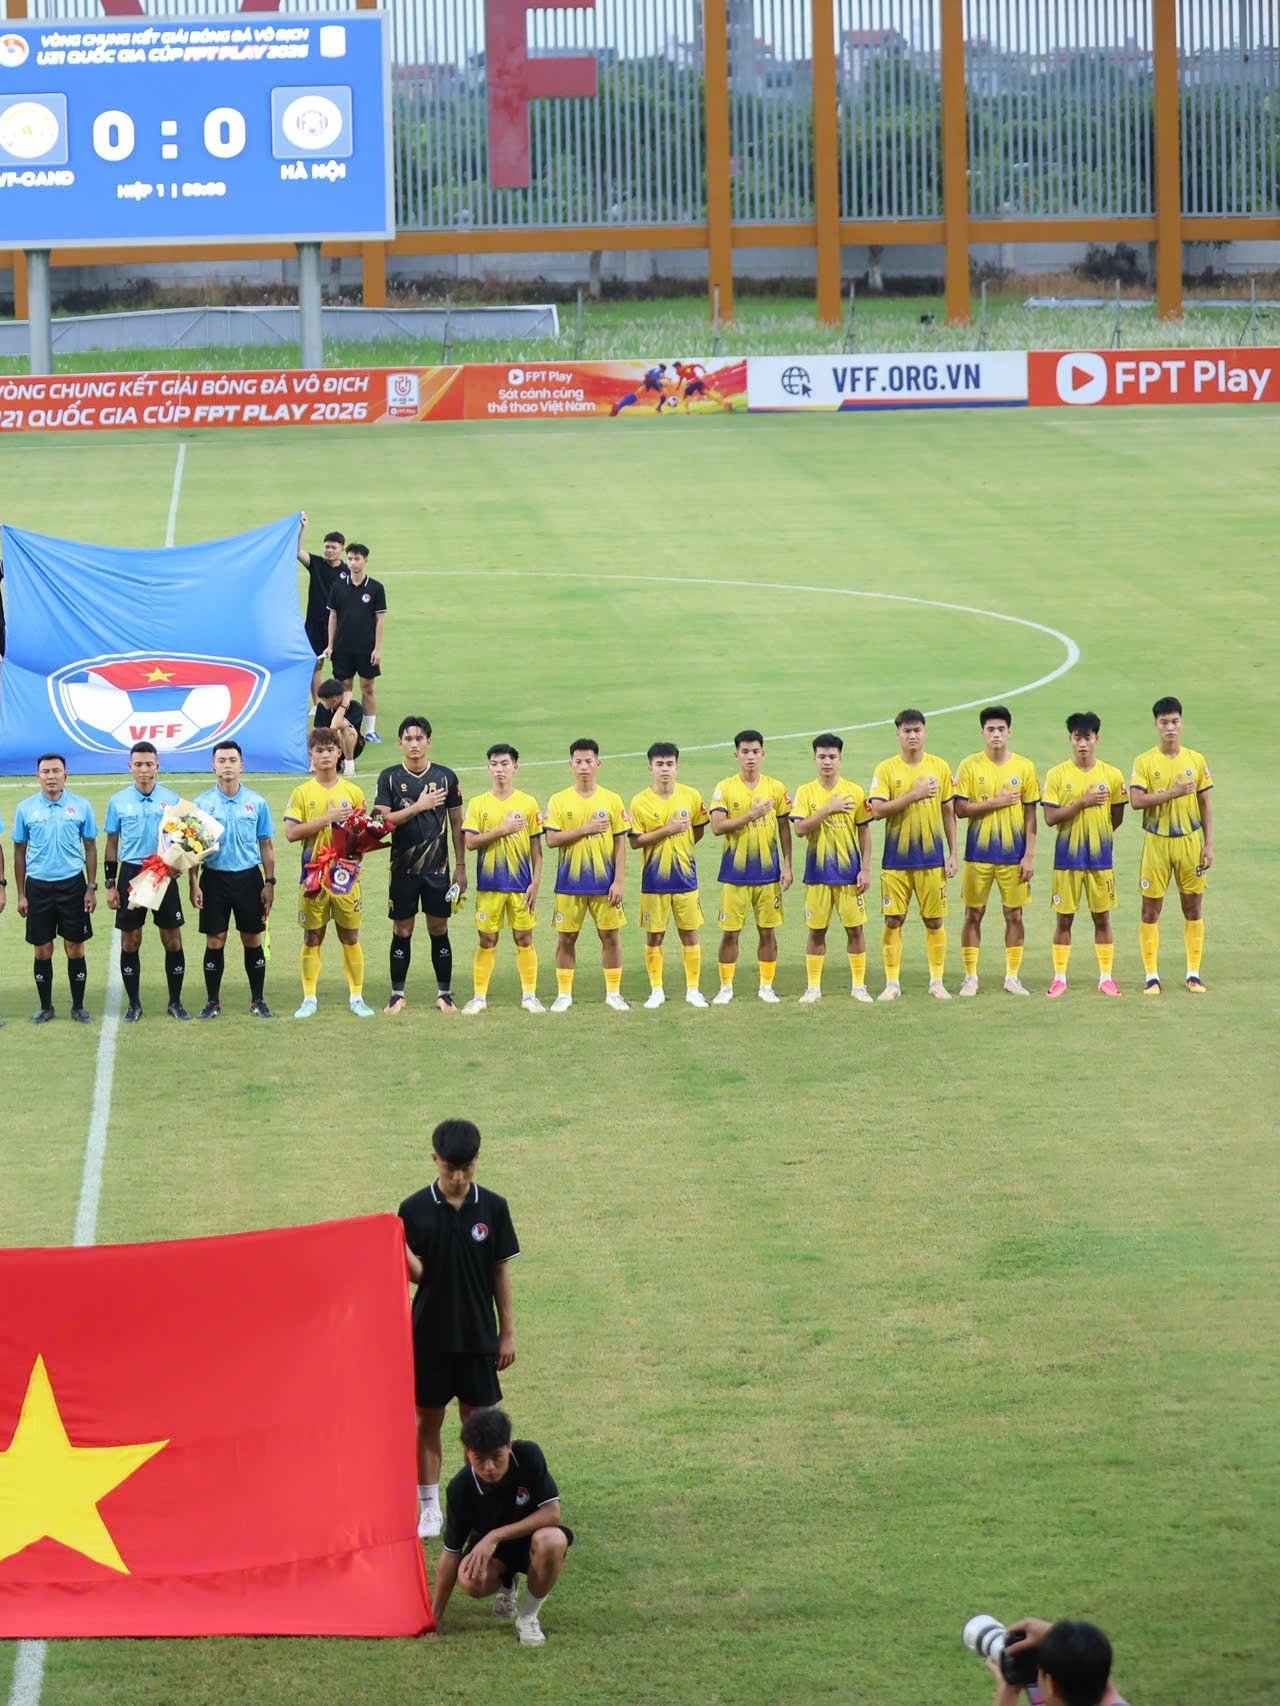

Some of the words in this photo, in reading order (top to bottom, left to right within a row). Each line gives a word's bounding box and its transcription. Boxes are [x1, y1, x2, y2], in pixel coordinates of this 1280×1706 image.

[92, 110, 135, 161] 0
[203, 107, 246, 159] 0
[280, 160, 309, 180] HÀ
[48, 382, 117, 399] CHUNG
[119, 373, 158, 397] KẾT
[161, 376, 198, 396] GIẢI
[201, 375, 258, 395] BÓNG
[260, 374, 289, 394] ĐÁ
[292, 373, 320, 393] VÔ
[323, 376, 369, 395] ĐỊCH
[525, 371, 547, 383] FPT
[549, 371, 573, 384] Play
[832, 364, 981, 393] VFF.ORG.VN
[1115, 361, 1185, 394] FPT
[1193, 359, 1271, 400] Play
[499, 388, 519, 400] Sát
[520, 387, 551, 400] cánh
[28, 400, 95, 426] QUỐC
[99, 407, 138, 425] GIA
[143, 400, 191, 423] CÚP
[193, 404, 241, 422] FPT
[242, 403, 308, 421] PLAY
[310, 402, 368, 420] 2026
[510, 402, 538, 412] thao
[540, 400, 563, 415] Việt
[565, 401, 596, 412] Nam
[129, 724, 183, 741] VFF
